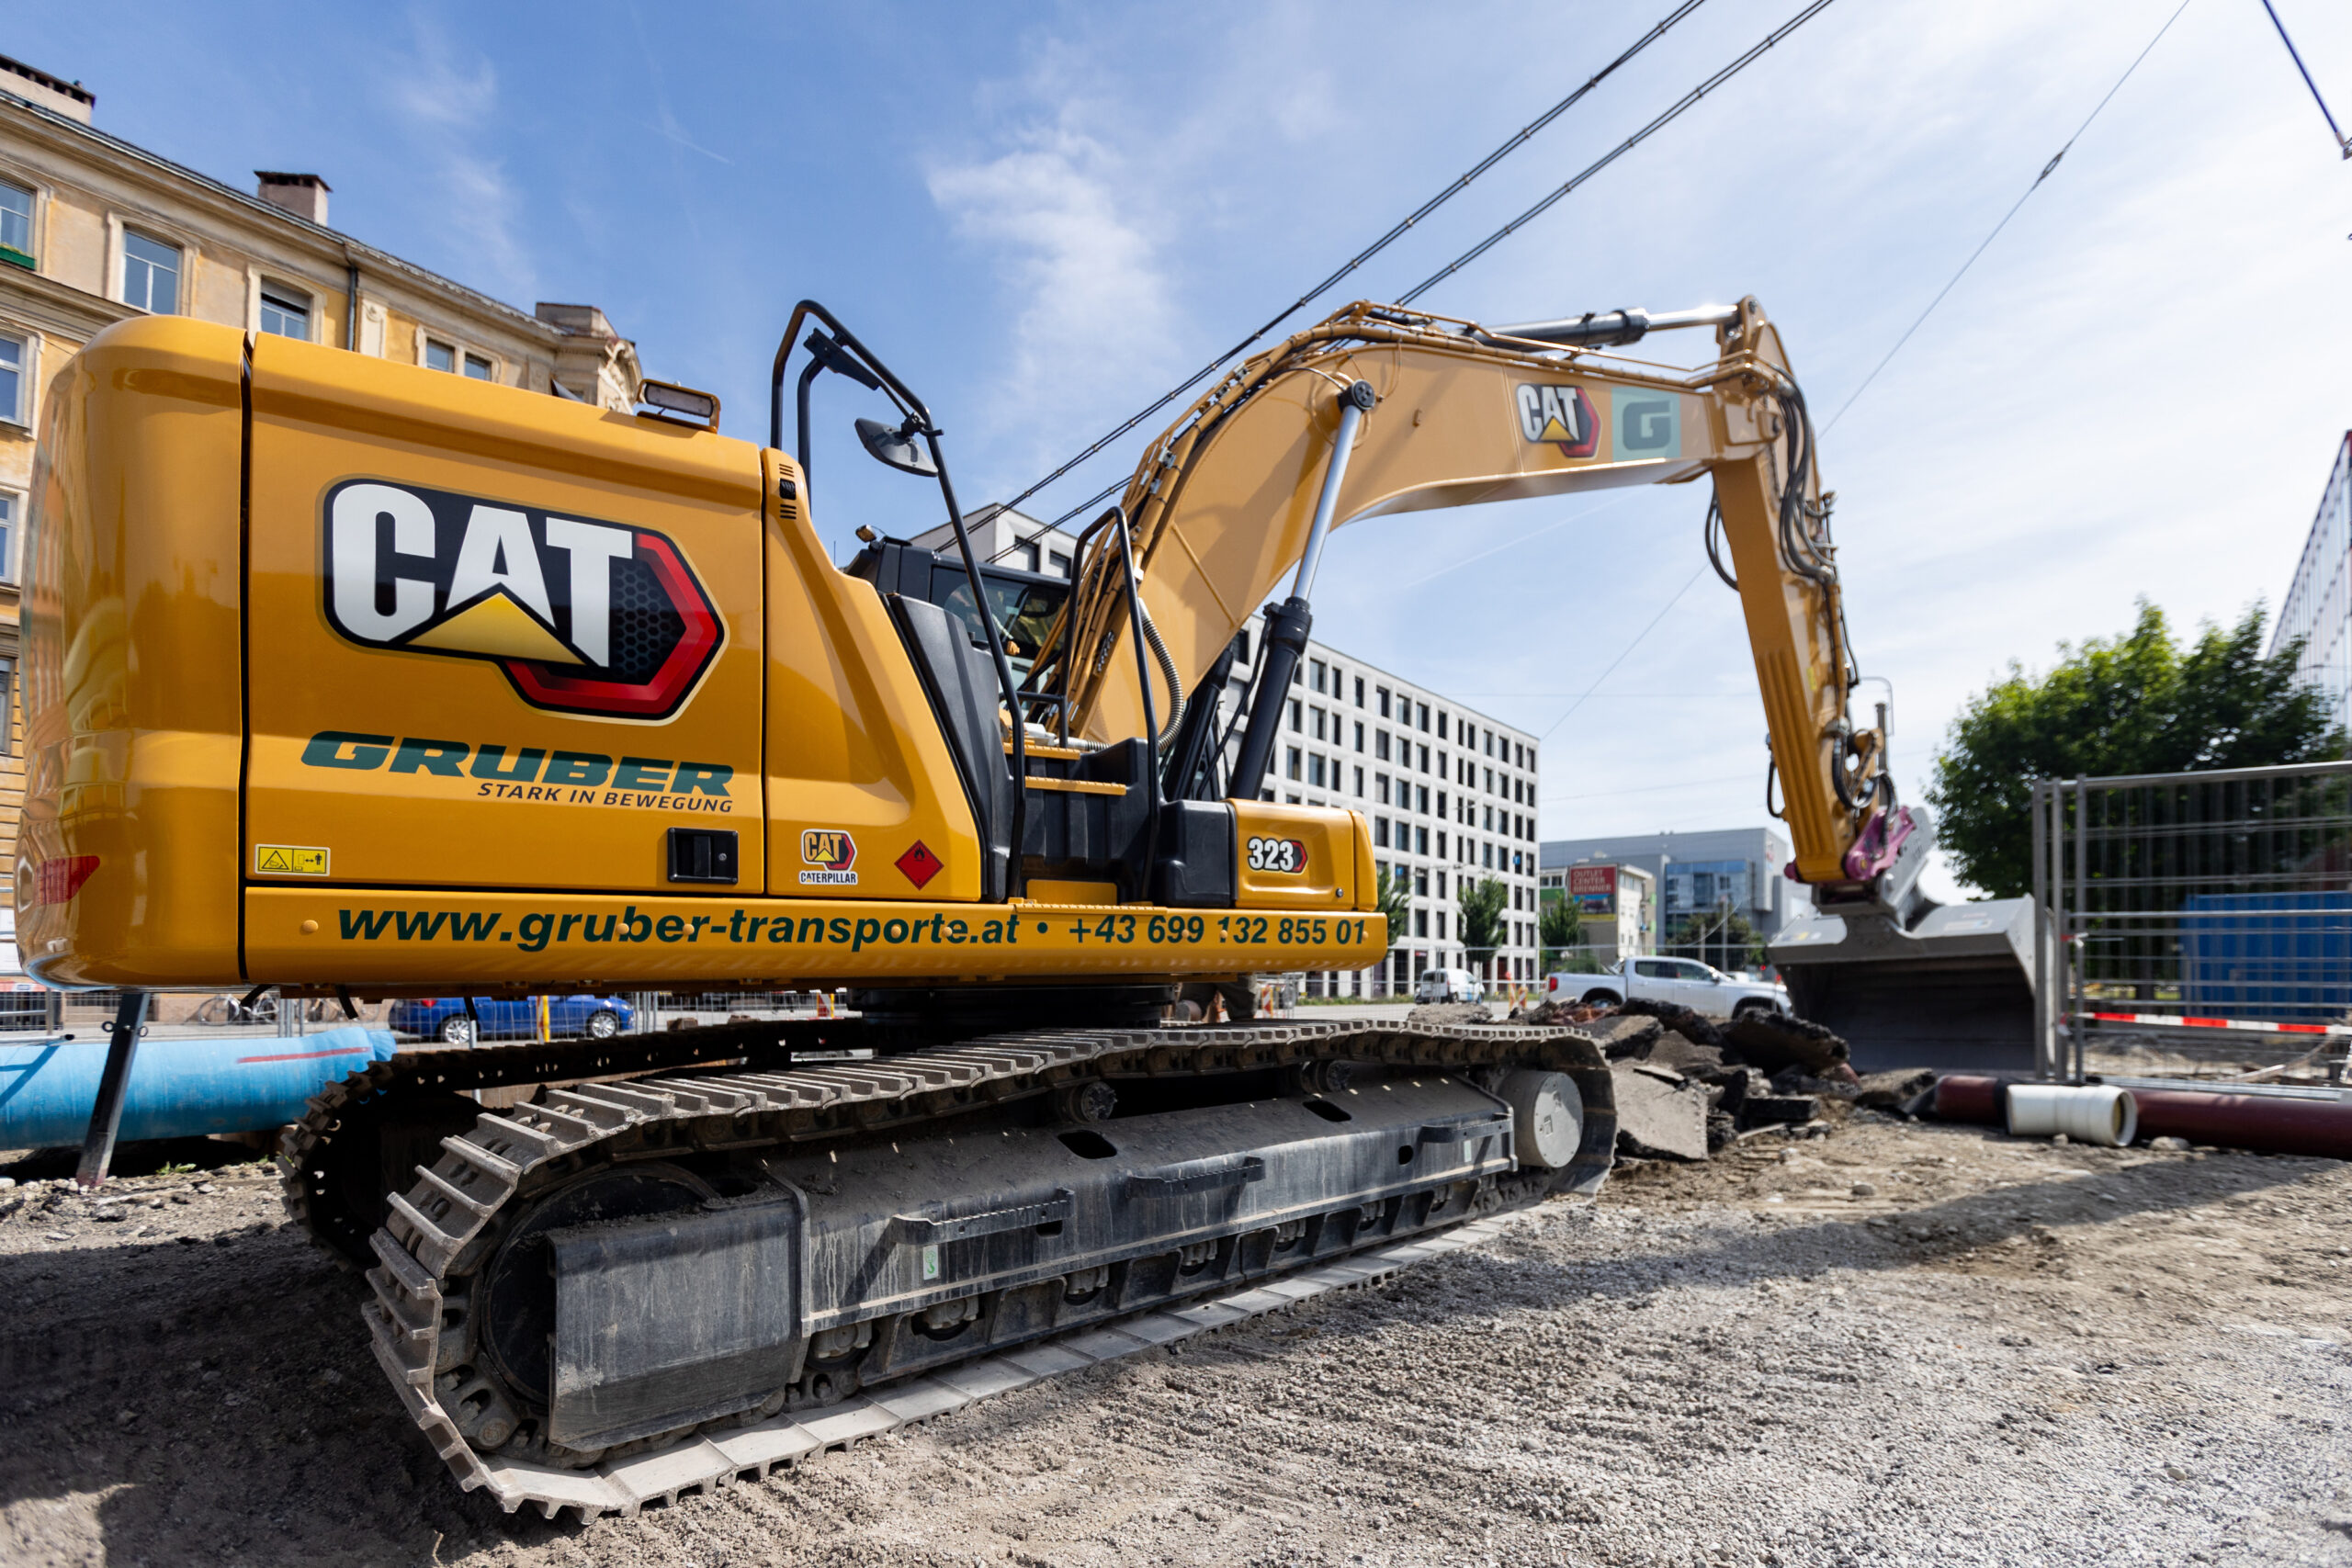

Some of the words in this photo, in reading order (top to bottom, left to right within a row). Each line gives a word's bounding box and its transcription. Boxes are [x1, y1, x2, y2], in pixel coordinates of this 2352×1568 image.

[1517, 384, 1580, 442] CAT
[1623, 400, 1671, 451] G
[333, 483, 633, 668] CAT
[300, 730, 735, 796] GRUBER
[478, 783, 562, 802] STARK
[569, 788, 594, 805] IN
[603, 792, 733, 813] BEWEGUNG
[804, 832, 842, 862] CAT
[1248, 838, 1294, 871] 323
[800, 873, 856, 884] CATERPILLAR
[339, 906, 1021, 953] www.gruber-transporte.at
[1069, 914, 1136, 944] +43
[1148, 915, 1204, 944] 699
[1216, 916, 1268, 944] 132
[1277, 919, 1328, 944] 855
[1336, 919, 1365, 945] 01
